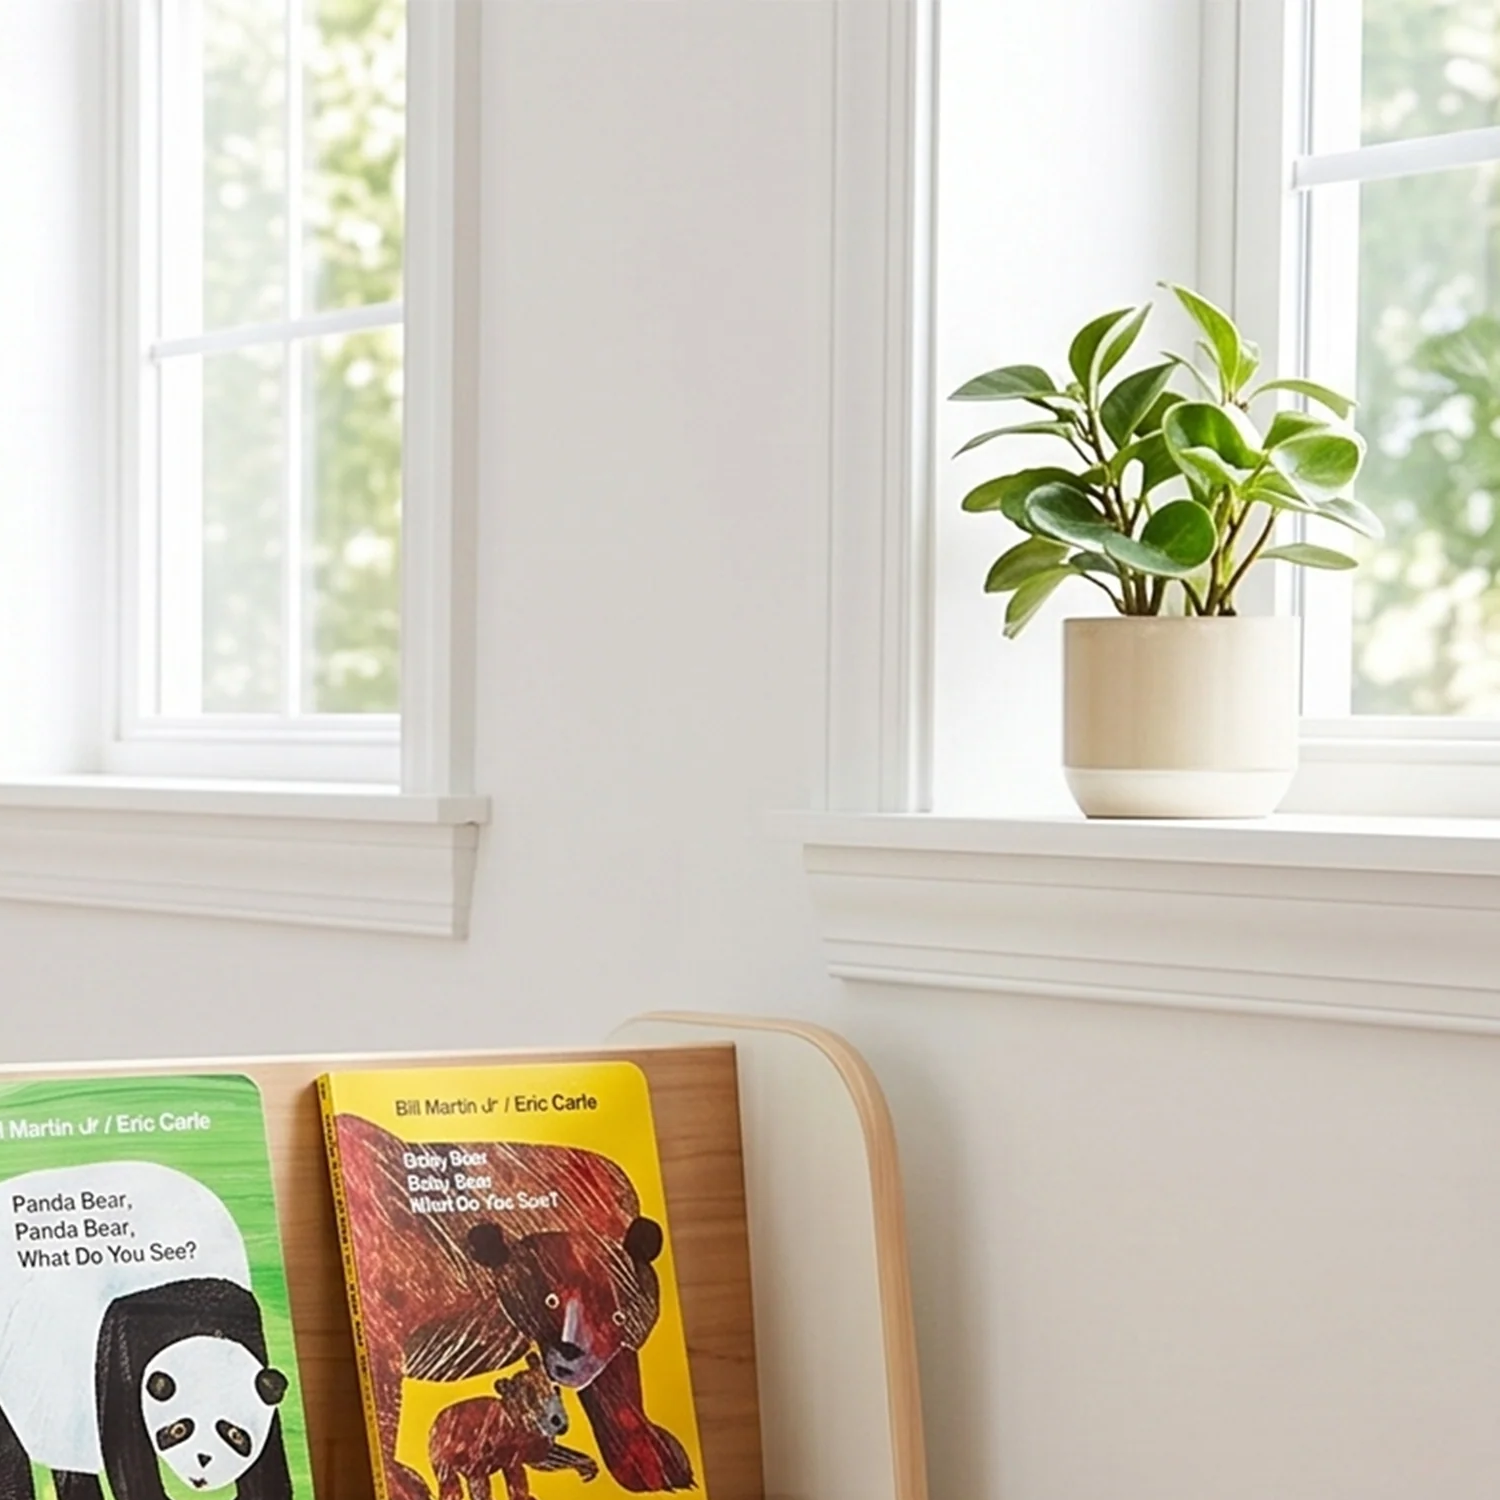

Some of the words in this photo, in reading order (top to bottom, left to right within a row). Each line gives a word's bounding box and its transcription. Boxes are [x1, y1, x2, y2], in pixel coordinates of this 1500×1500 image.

[395, 1100, 421, 1116] Bill
[425, 1098, 477, 1115] Martin
[514, 1095, 548, 1112] Eric
[551, 1093, 597, 1111] Carle
[9, 1118, 73, 1138] Martin
[116, 1114, 155, 1133] Eric
[12, 1193, 76, 1213] Panda
[81, 1191, 133, 1211] Bear,
[15, 1221, 78, 1241] Panda
[84, 1218, 135, 1238] Bear,
[17, 1249, 70, 1268] What
[75, 1247, 103, 1266] Do
[107, 1245, 145, 1264] You
[149, 1241, 197, 1262] See?
